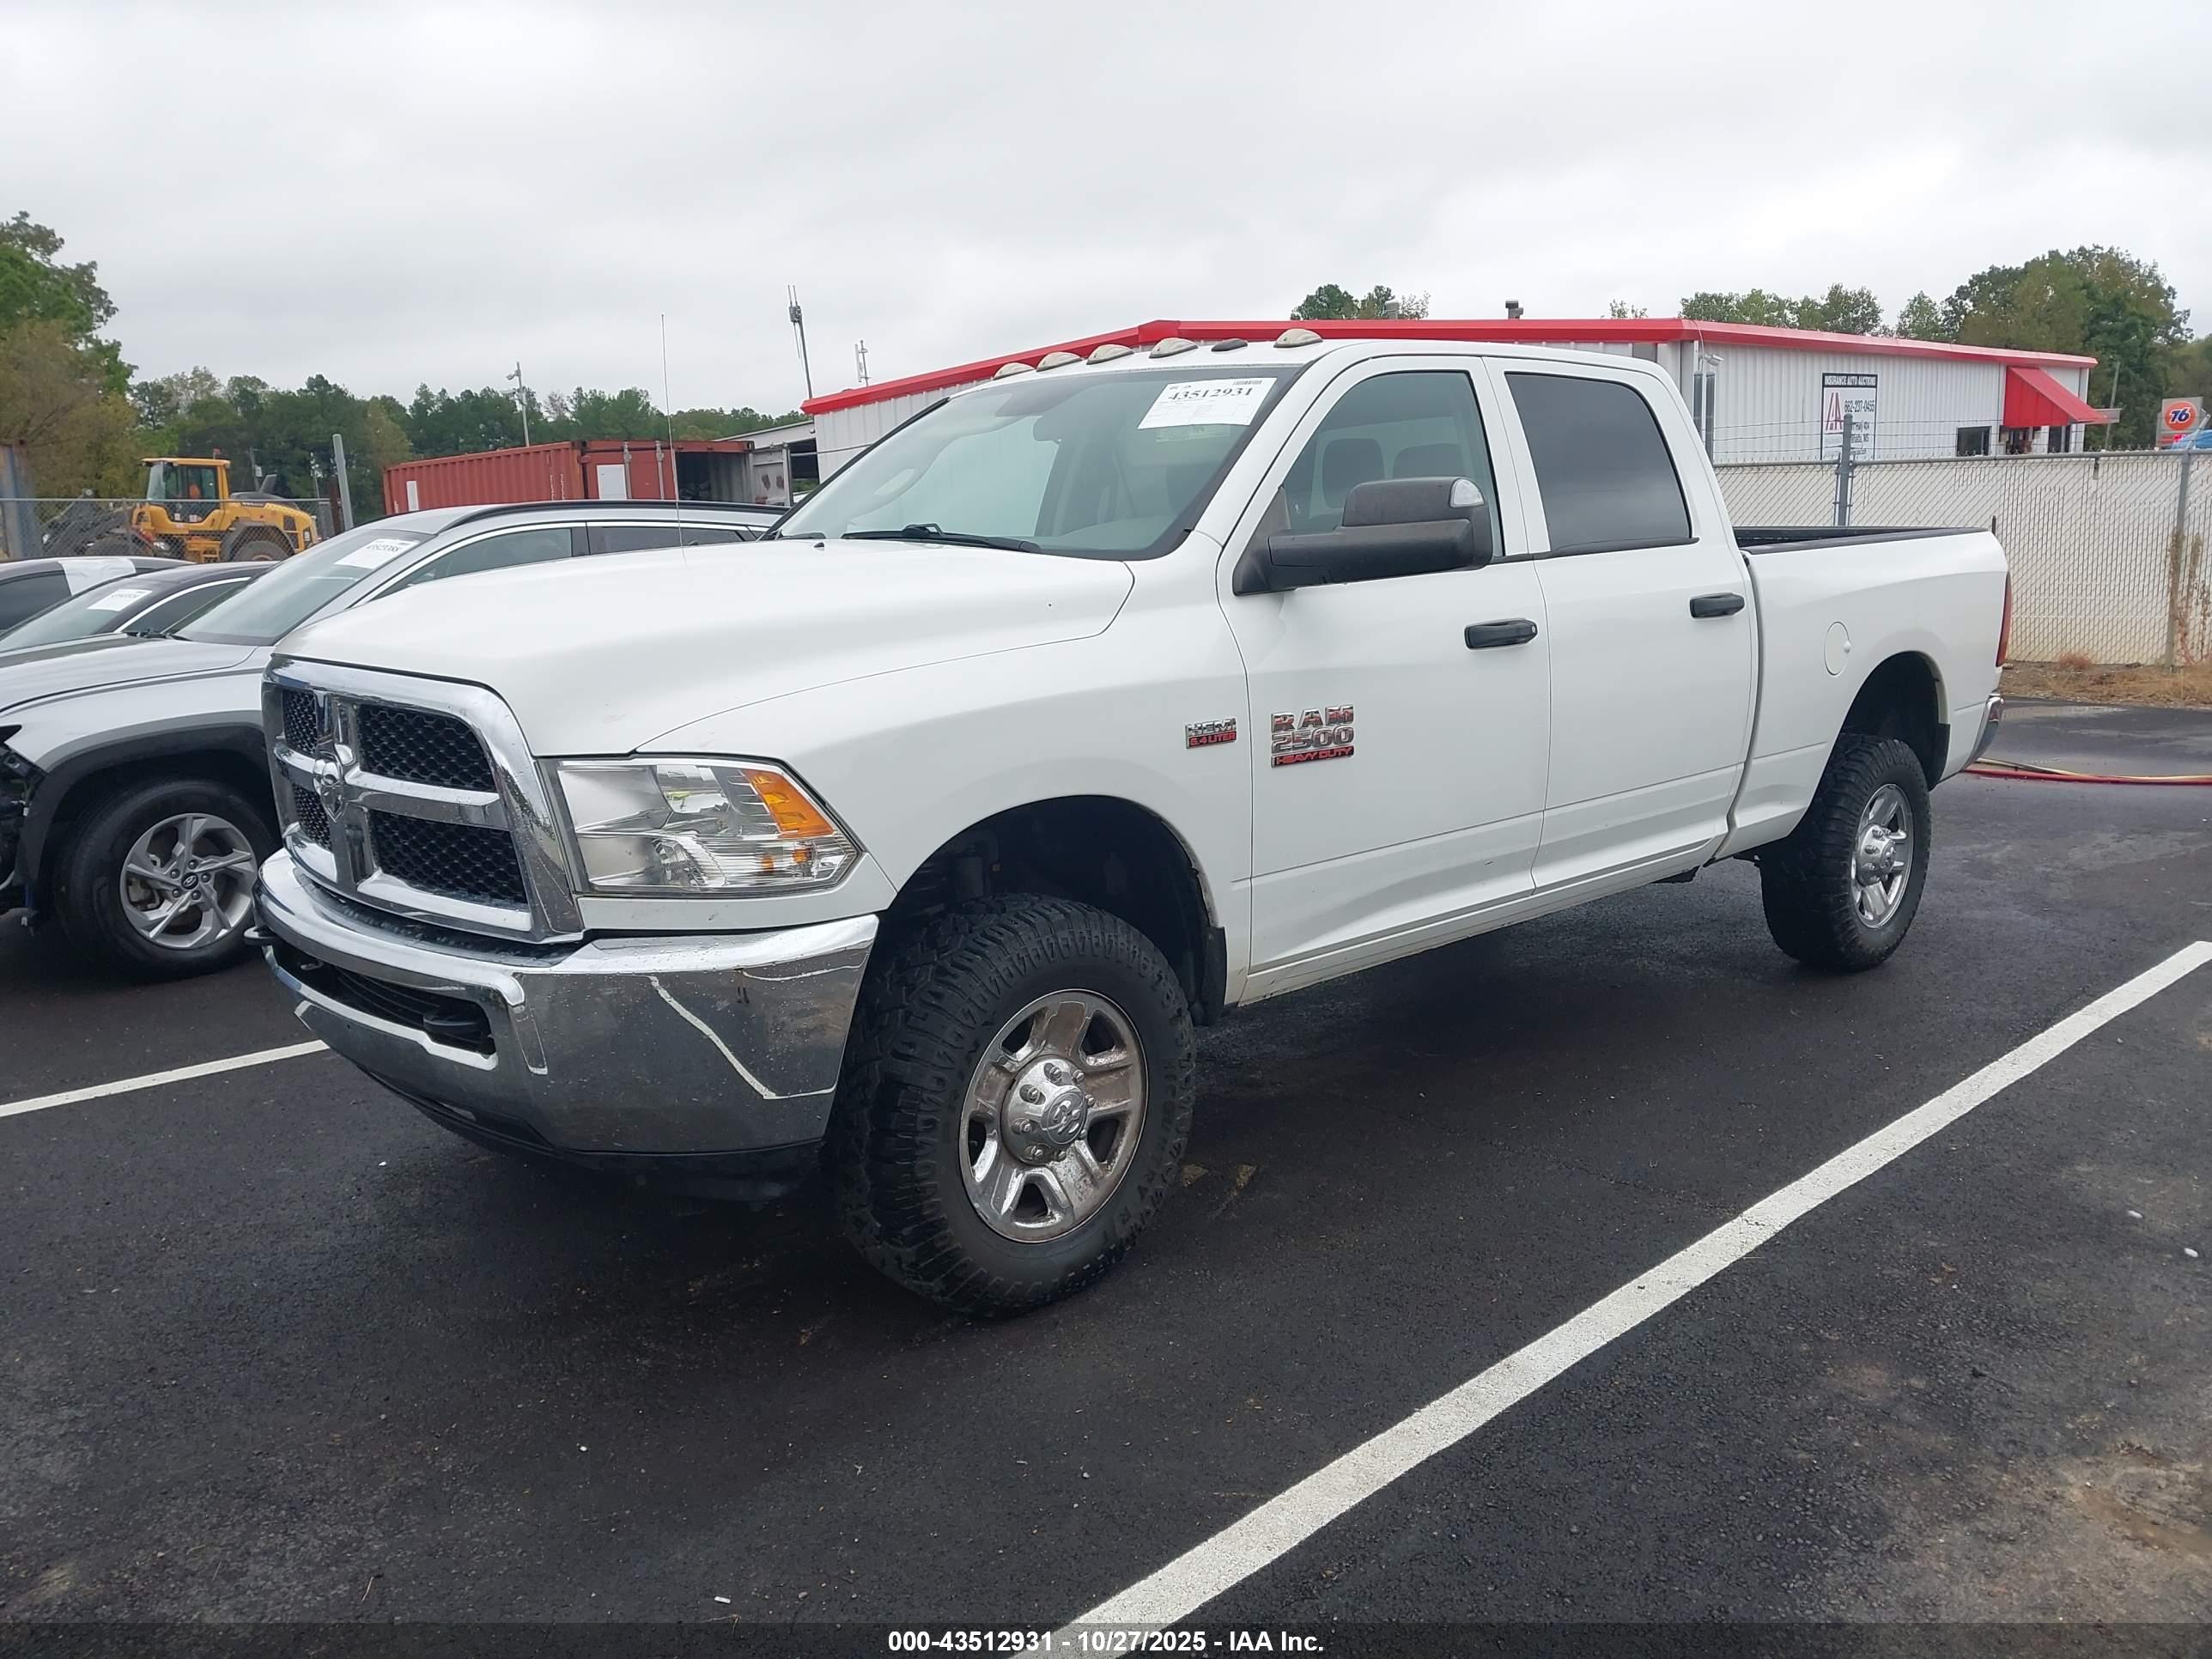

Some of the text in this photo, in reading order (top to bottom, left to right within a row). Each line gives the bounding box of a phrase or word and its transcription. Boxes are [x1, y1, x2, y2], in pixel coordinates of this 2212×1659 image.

[1825, 375, 1876, 386] INSURANCE AUTO AUCTIONS
[1168, 387, 1253, 400] 43512931
[2169, 407, 2191, 423] 76
[1187, 718, 1237, 736] HEMI
[1271, 704, 1354, 733] RAM
[1208, 732, 1236, 743] LITER
[1271, 725, 1354, 753] 2500
[1276, 747, 1352, 765] HEAVY DUTY
